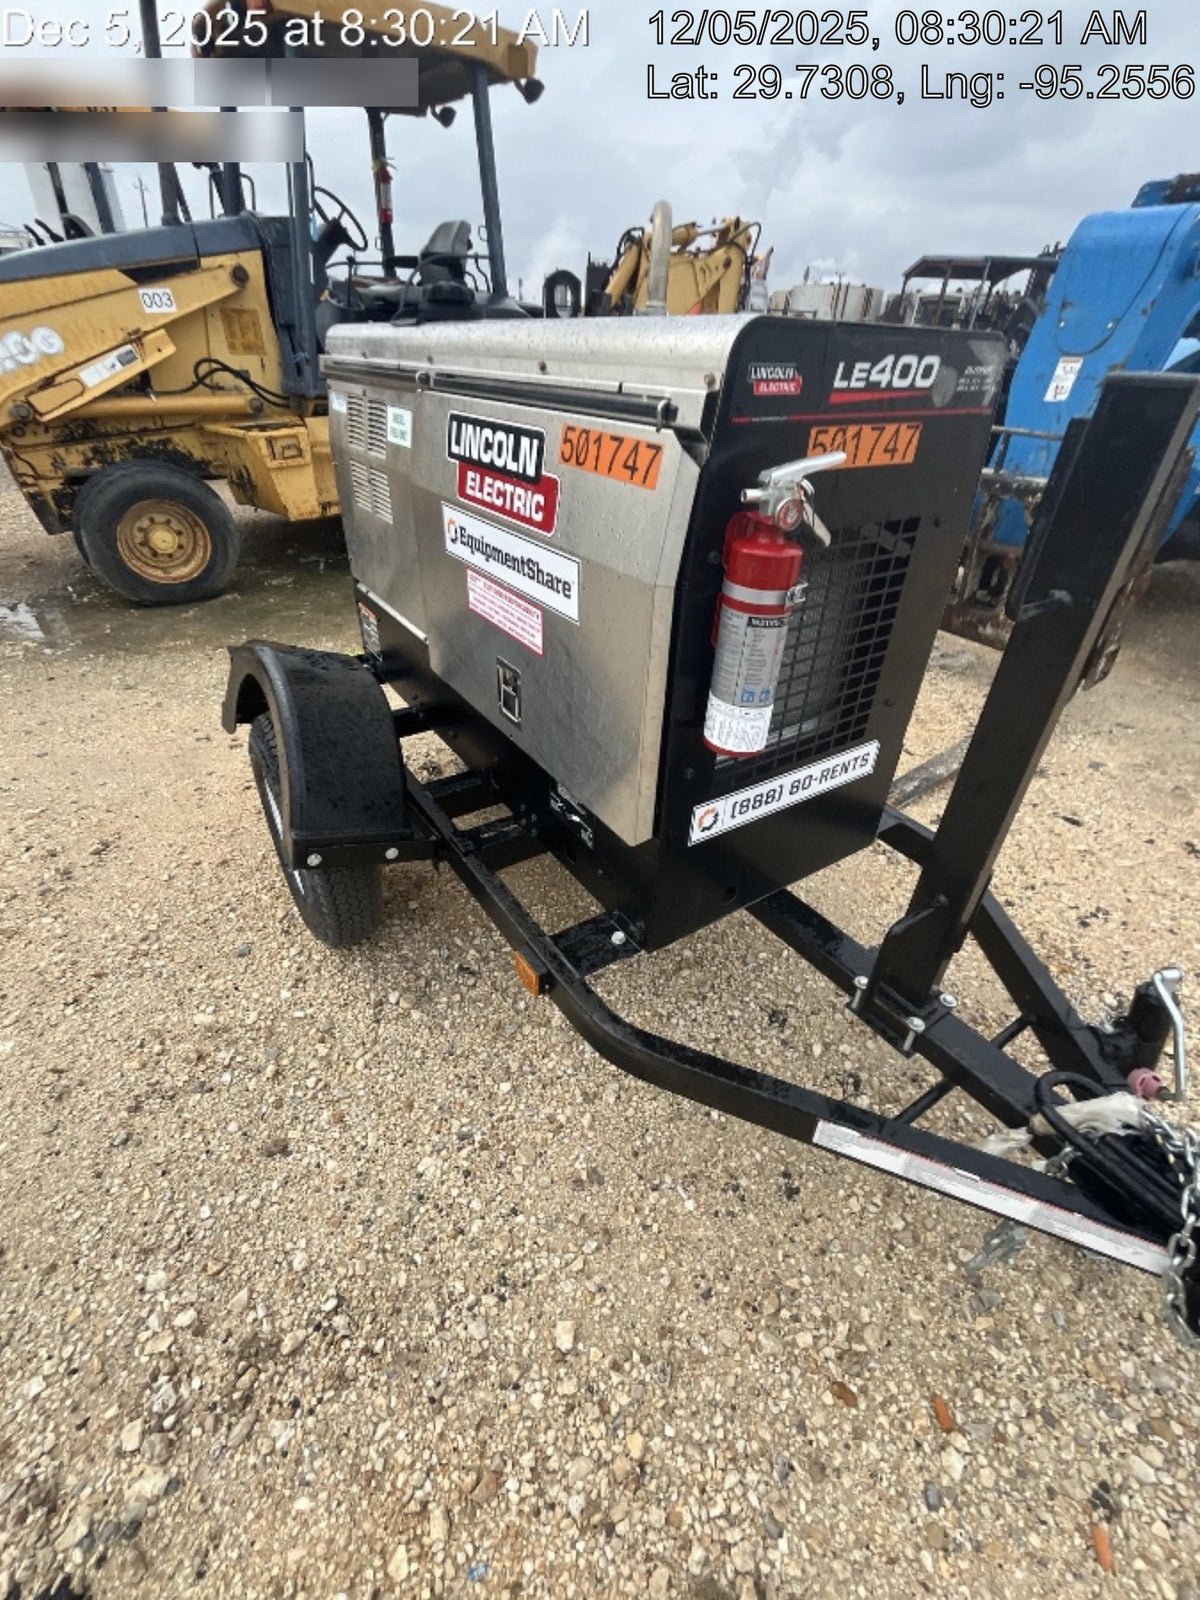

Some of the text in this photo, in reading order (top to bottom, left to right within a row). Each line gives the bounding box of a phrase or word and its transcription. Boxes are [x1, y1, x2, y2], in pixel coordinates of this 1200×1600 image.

[141, 291, 174, 309] 003
[750, 365, 795, 380] LINCOLN
[833, 354, 942, 389] LE400
[450, 420, 540, 478] LINCOLN
[560, 425, 663, 485] 501747
[811, 424, 921, 464] 501747
[465, 470, 545, 523] ELECTRIC
[459, 525, 572, 600] EquipmentShare
[729, 752, 871, 819] (888) 80-RENTS
